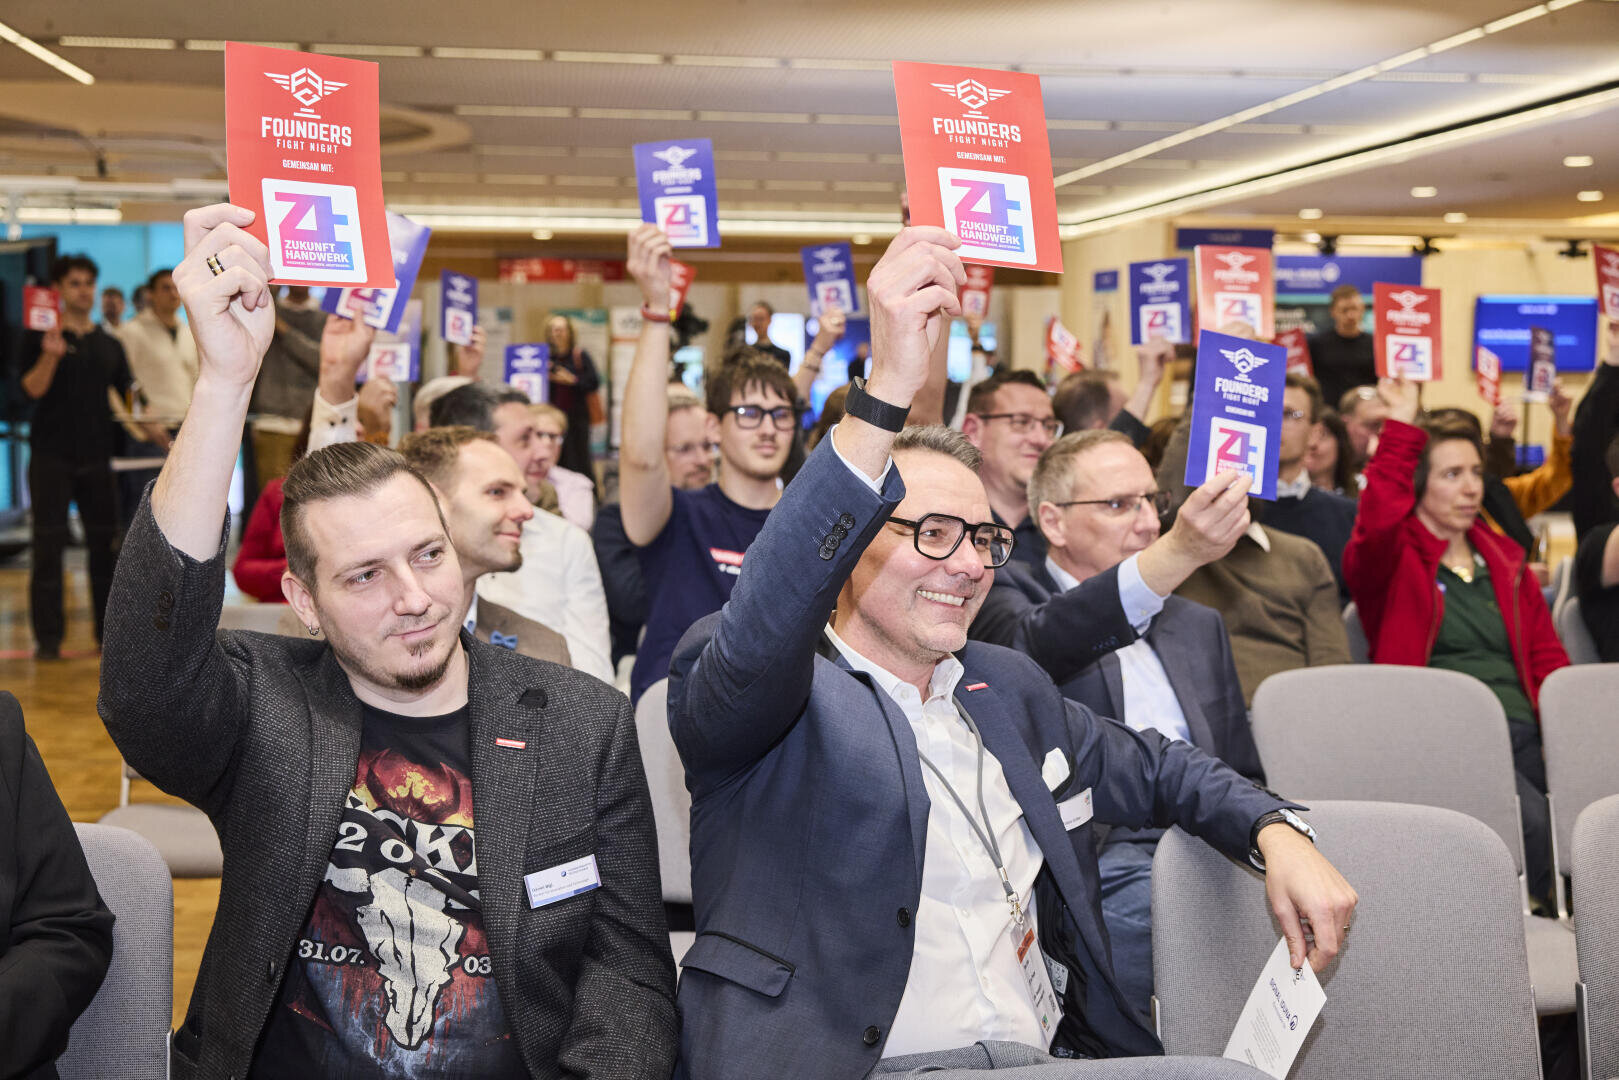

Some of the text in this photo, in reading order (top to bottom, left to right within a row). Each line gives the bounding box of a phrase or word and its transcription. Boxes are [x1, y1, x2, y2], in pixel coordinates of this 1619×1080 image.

[261, 116, 352, 147] FOUNDERS
[932, 117, 1022, 143] FOUNDERS
[276, 138, 338, 154] FIGHT NIGHT
[949, 134, 1009, 149] FIGHT NIGHT
[956, 151, 992, 162] GEMEINSAM
[282, 159, 334, 173] GEMEINSAM MIT:
[959, 220, 1009, 235] ZUKUNFT
[960, 229, 1020, 246] HANDWERK
[284, 239, 336, 253] ZUKUNFT
[285, 249, 349, 263] HANDWERK
[1214, 377, 1270, 403] FOUNDERS
[298, 939, 366, 965] 31.07.
